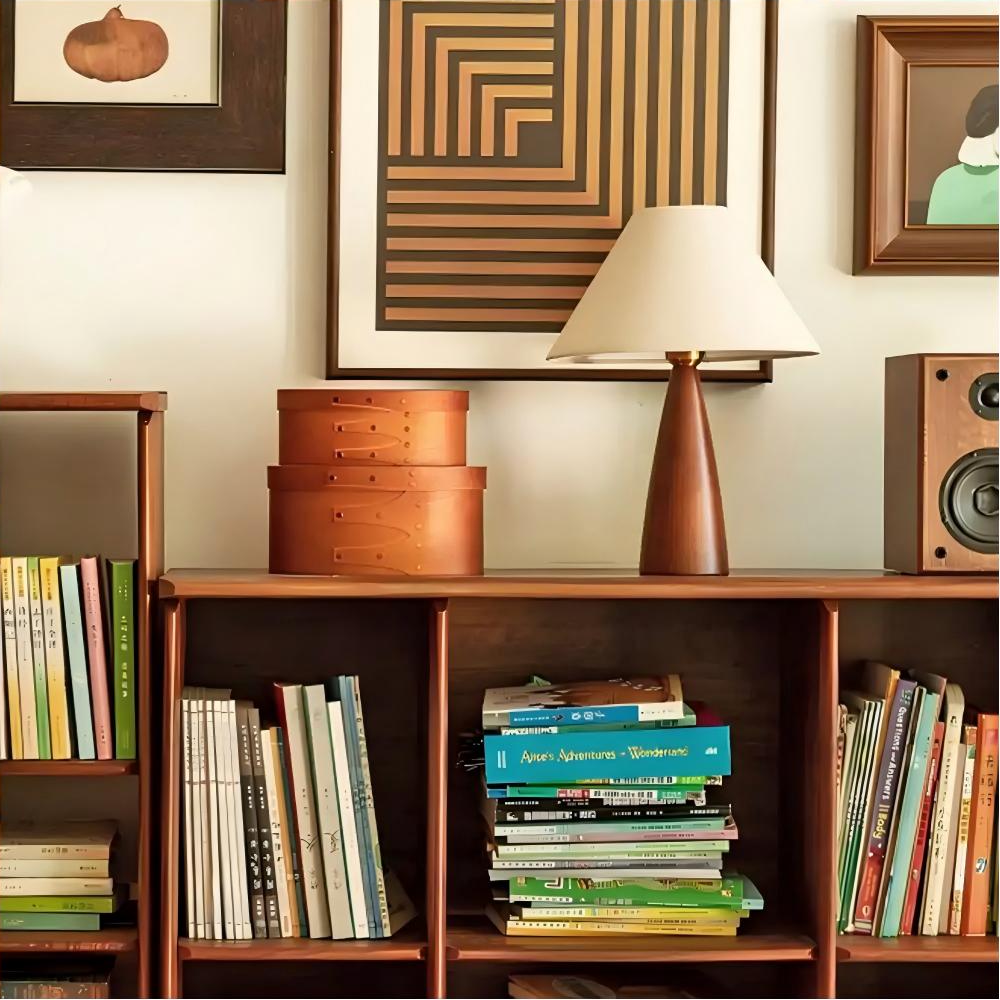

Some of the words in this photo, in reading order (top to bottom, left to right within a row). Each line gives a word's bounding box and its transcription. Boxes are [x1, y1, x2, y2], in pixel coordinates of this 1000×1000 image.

[557, 748, 617, 762] Adventures
[882, 761, 897, 800] Answers
[873, 811, 888, 840] Body
